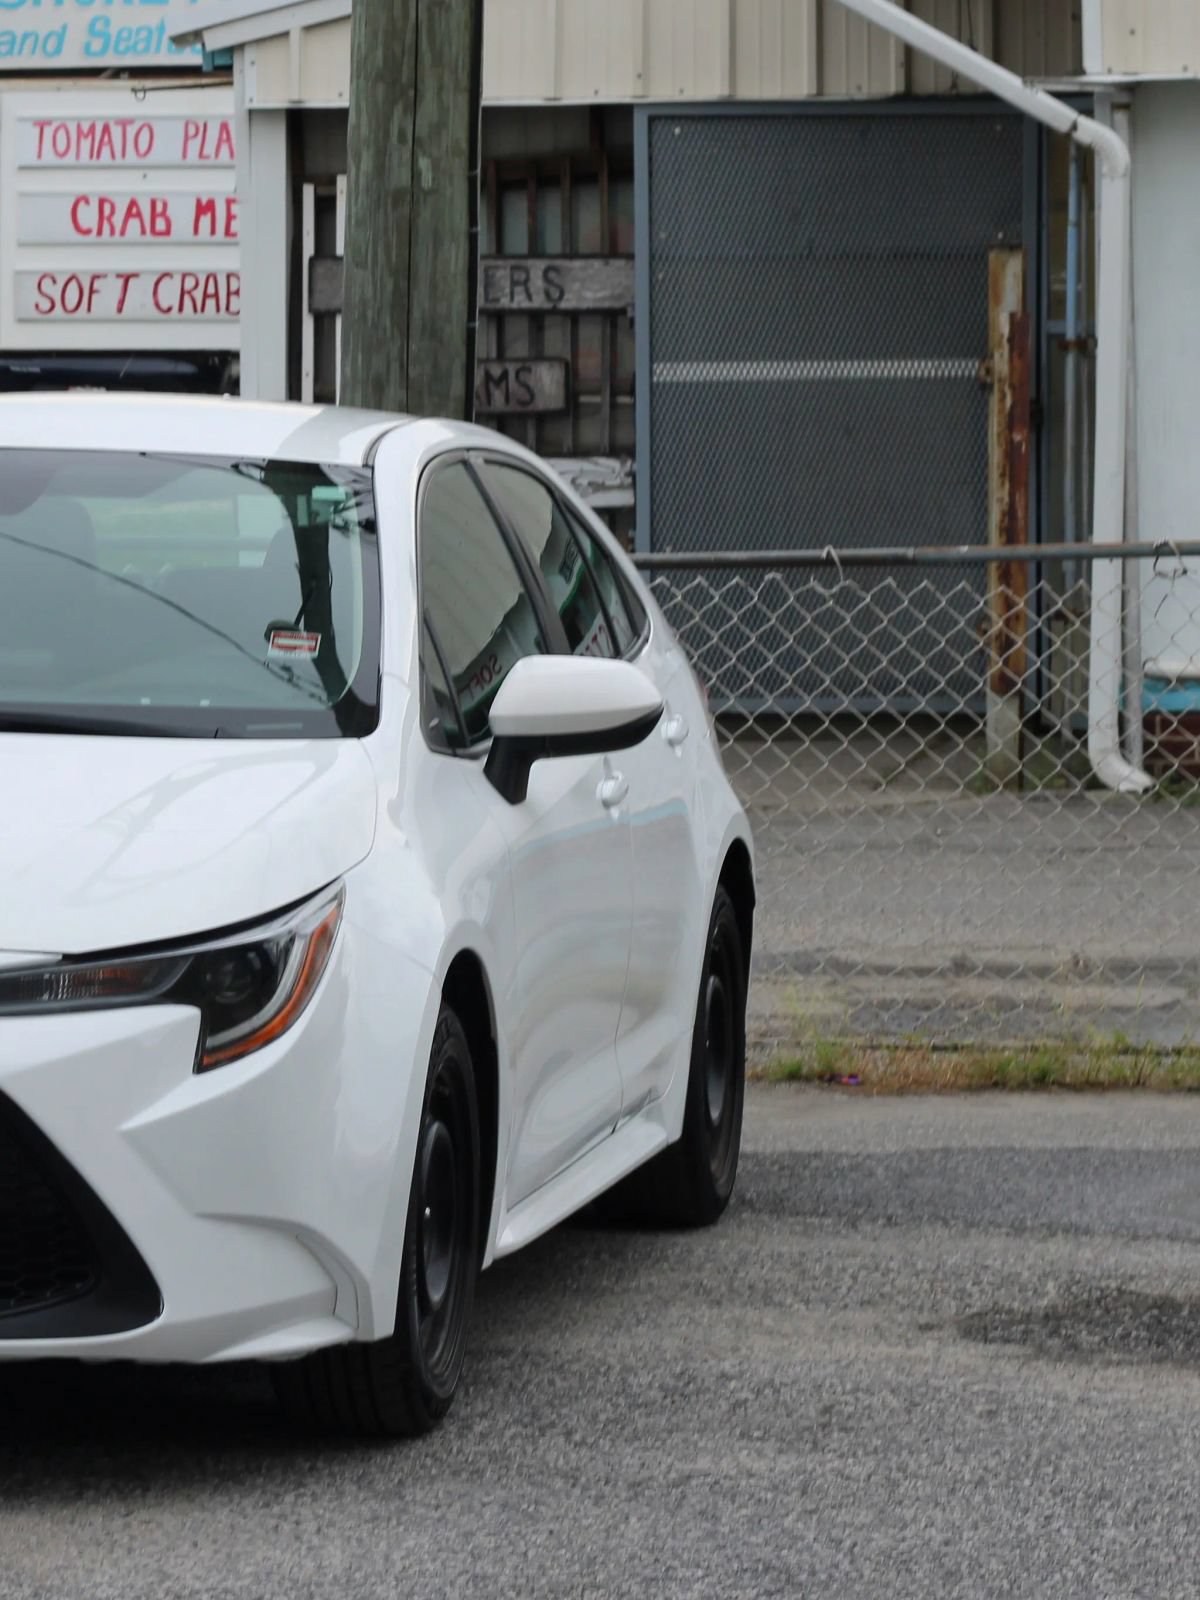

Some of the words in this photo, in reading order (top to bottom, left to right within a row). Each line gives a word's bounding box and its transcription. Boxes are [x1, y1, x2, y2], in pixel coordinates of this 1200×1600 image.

[83, 14, 202, 58] Seaf
[32, 118, 154, 161] TOMATO
[182, 120, 235, 161] PLA
[70, 194, 173, 238] CRAB
[192, 196, 238, 238] ME
[33, 272, 140, 316] SOFT
[152, 271, 240, 316] CRAB
[475, 366, 536, 407] MS
